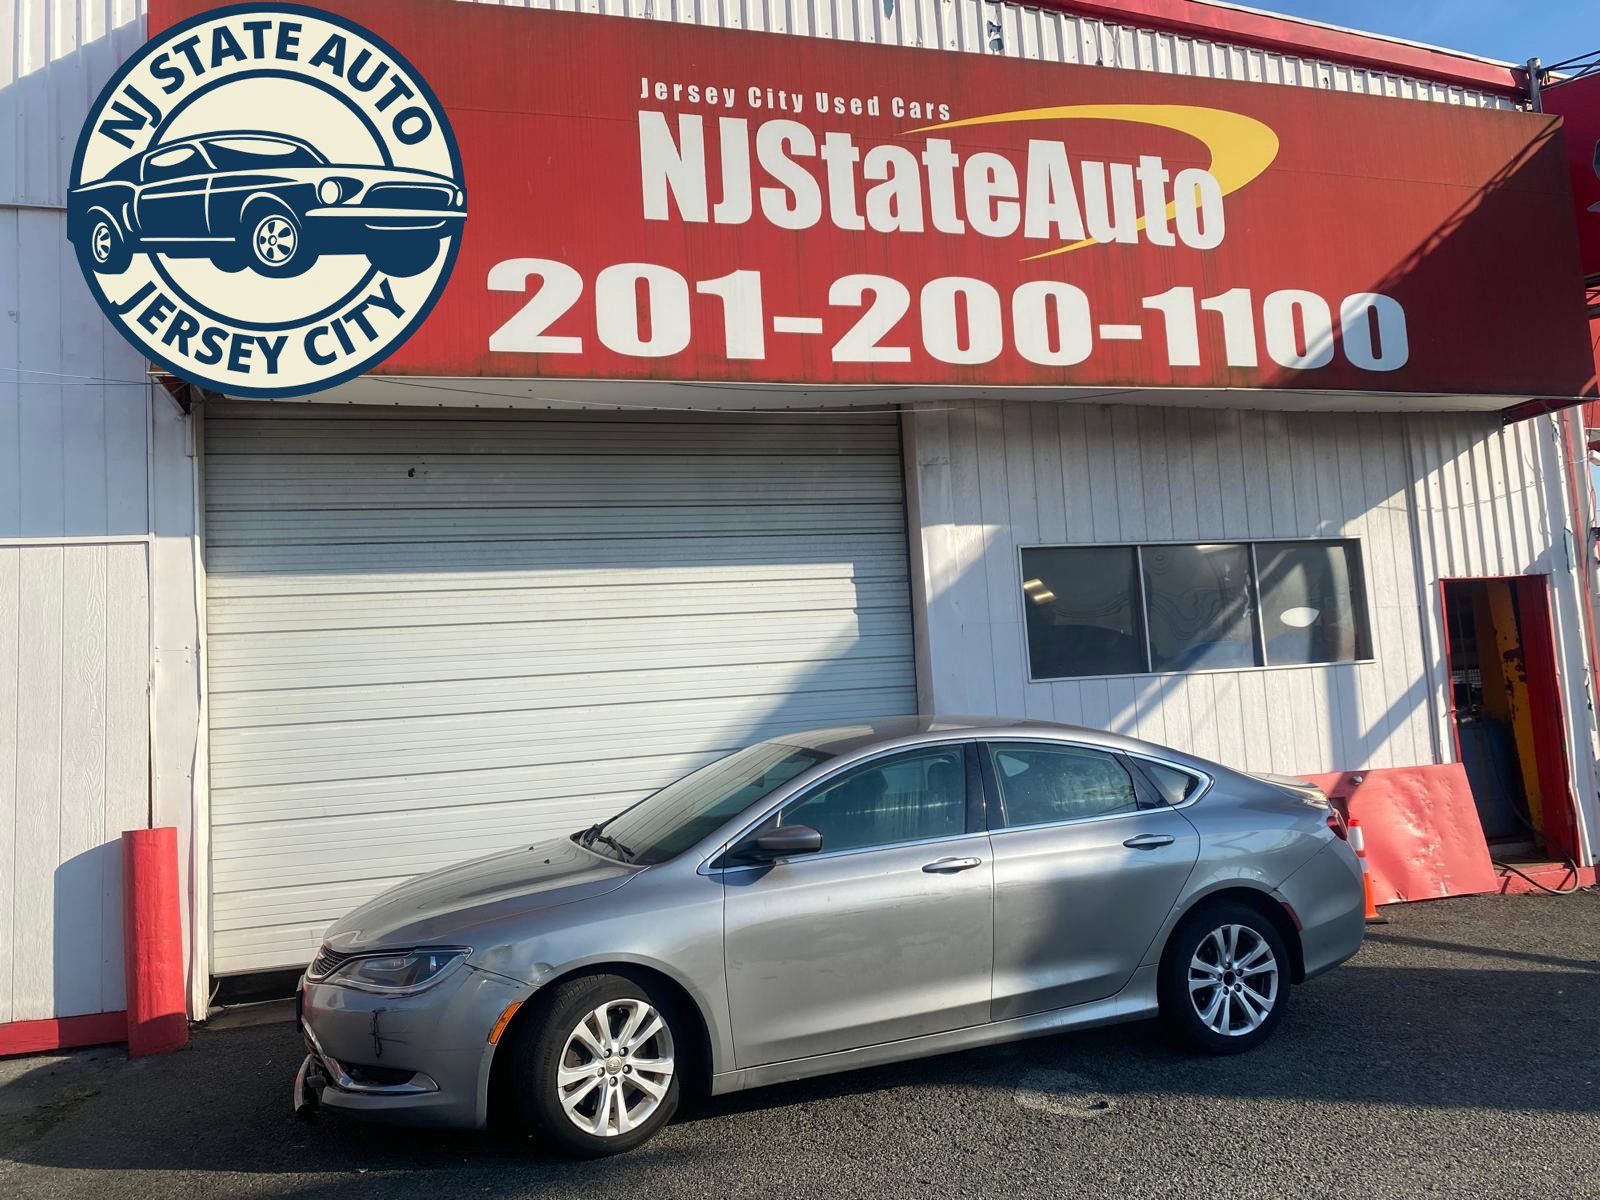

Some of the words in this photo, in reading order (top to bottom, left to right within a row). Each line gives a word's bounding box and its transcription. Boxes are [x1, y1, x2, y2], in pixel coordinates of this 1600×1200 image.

[640, 77, 736, 109] Jersey
[748, 86, 804, 113] City
[815, 91, 880, 117] Used
[891, 96, 951, 121] Cars
[638, 110, 1226, 250] NJStateAuto
[487, 257, 1409, 372] 201-200-1100
